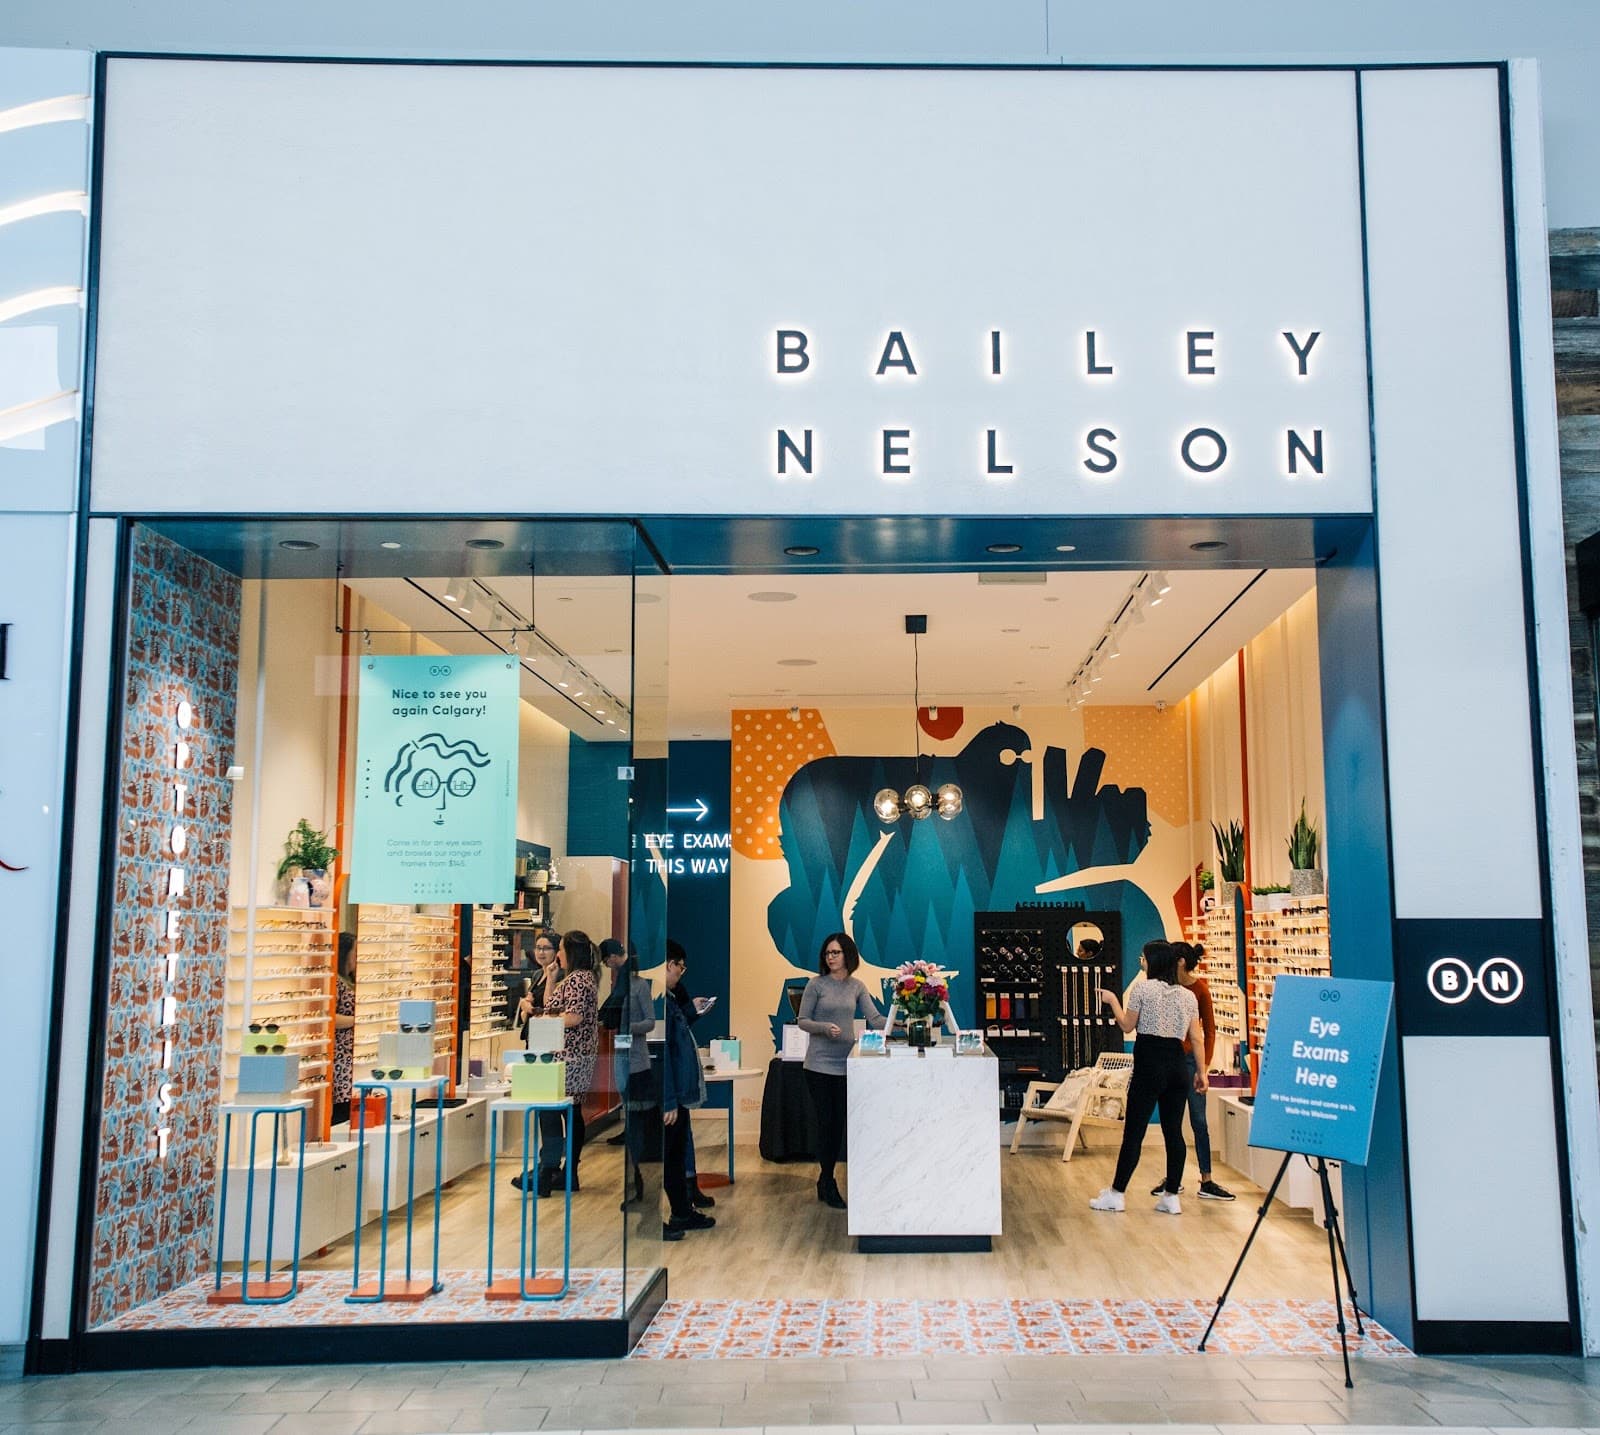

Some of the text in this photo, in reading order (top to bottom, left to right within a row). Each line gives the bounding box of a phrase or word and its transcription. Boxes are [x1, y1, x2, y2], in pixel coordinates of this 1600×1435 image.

[776, 330, 1321, 375] BAILEY
[777, 428, 1324, 474] NELSON
[392, 689, 487, 701] Nice to see you
[392, 705, 486, 718] again Calgary!
[644, 833, 674, 849] EYE
[645, 858, 685, 874] THIS
[690, 858, 729, 874] WAY
[155, 700, 193, 1159] OPTOMETRIST
[1309, 1016, 1340, 1038] Eye
[1292, 1040, 1349, 1064] Exams
[1296, 1066, 1338, 1089] Here
